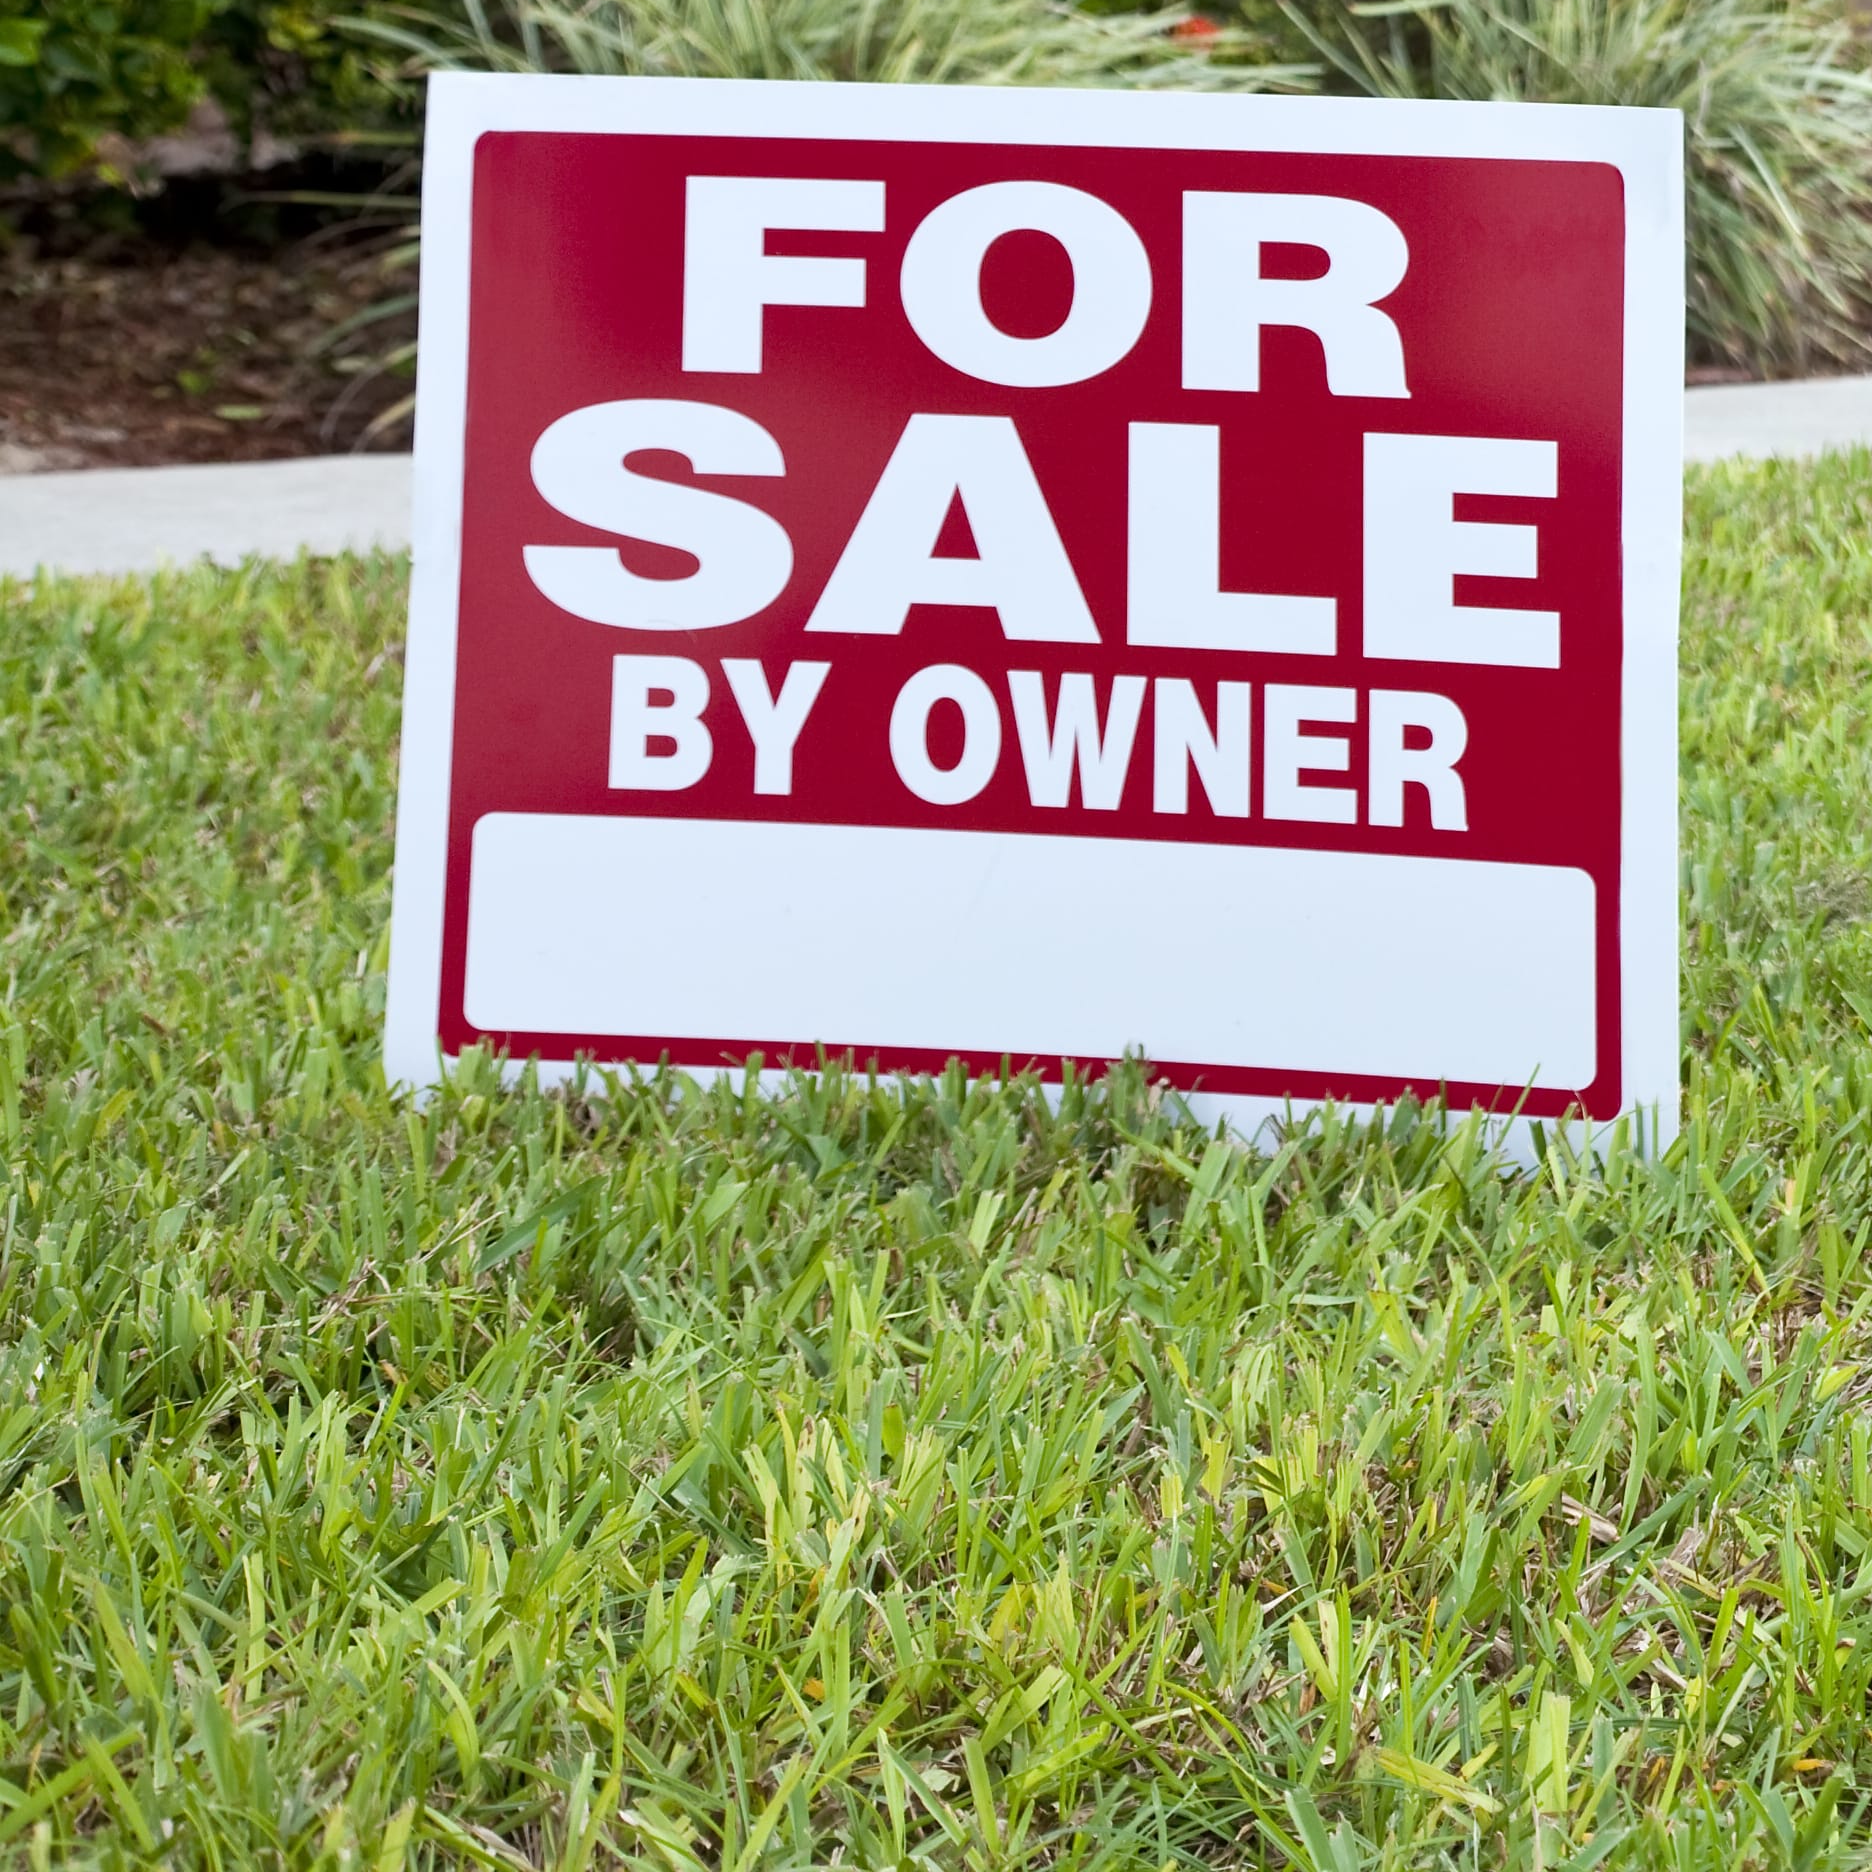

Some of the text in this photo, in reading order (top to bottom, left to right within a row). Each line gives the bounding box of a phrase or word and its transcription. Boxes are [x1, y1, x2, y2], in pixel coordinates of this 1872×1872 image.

[682, 176, 1412, 399] FOR
[523, 399, 1561, 669] SALE
[608, 655, 1469, 832] BY OWNER
